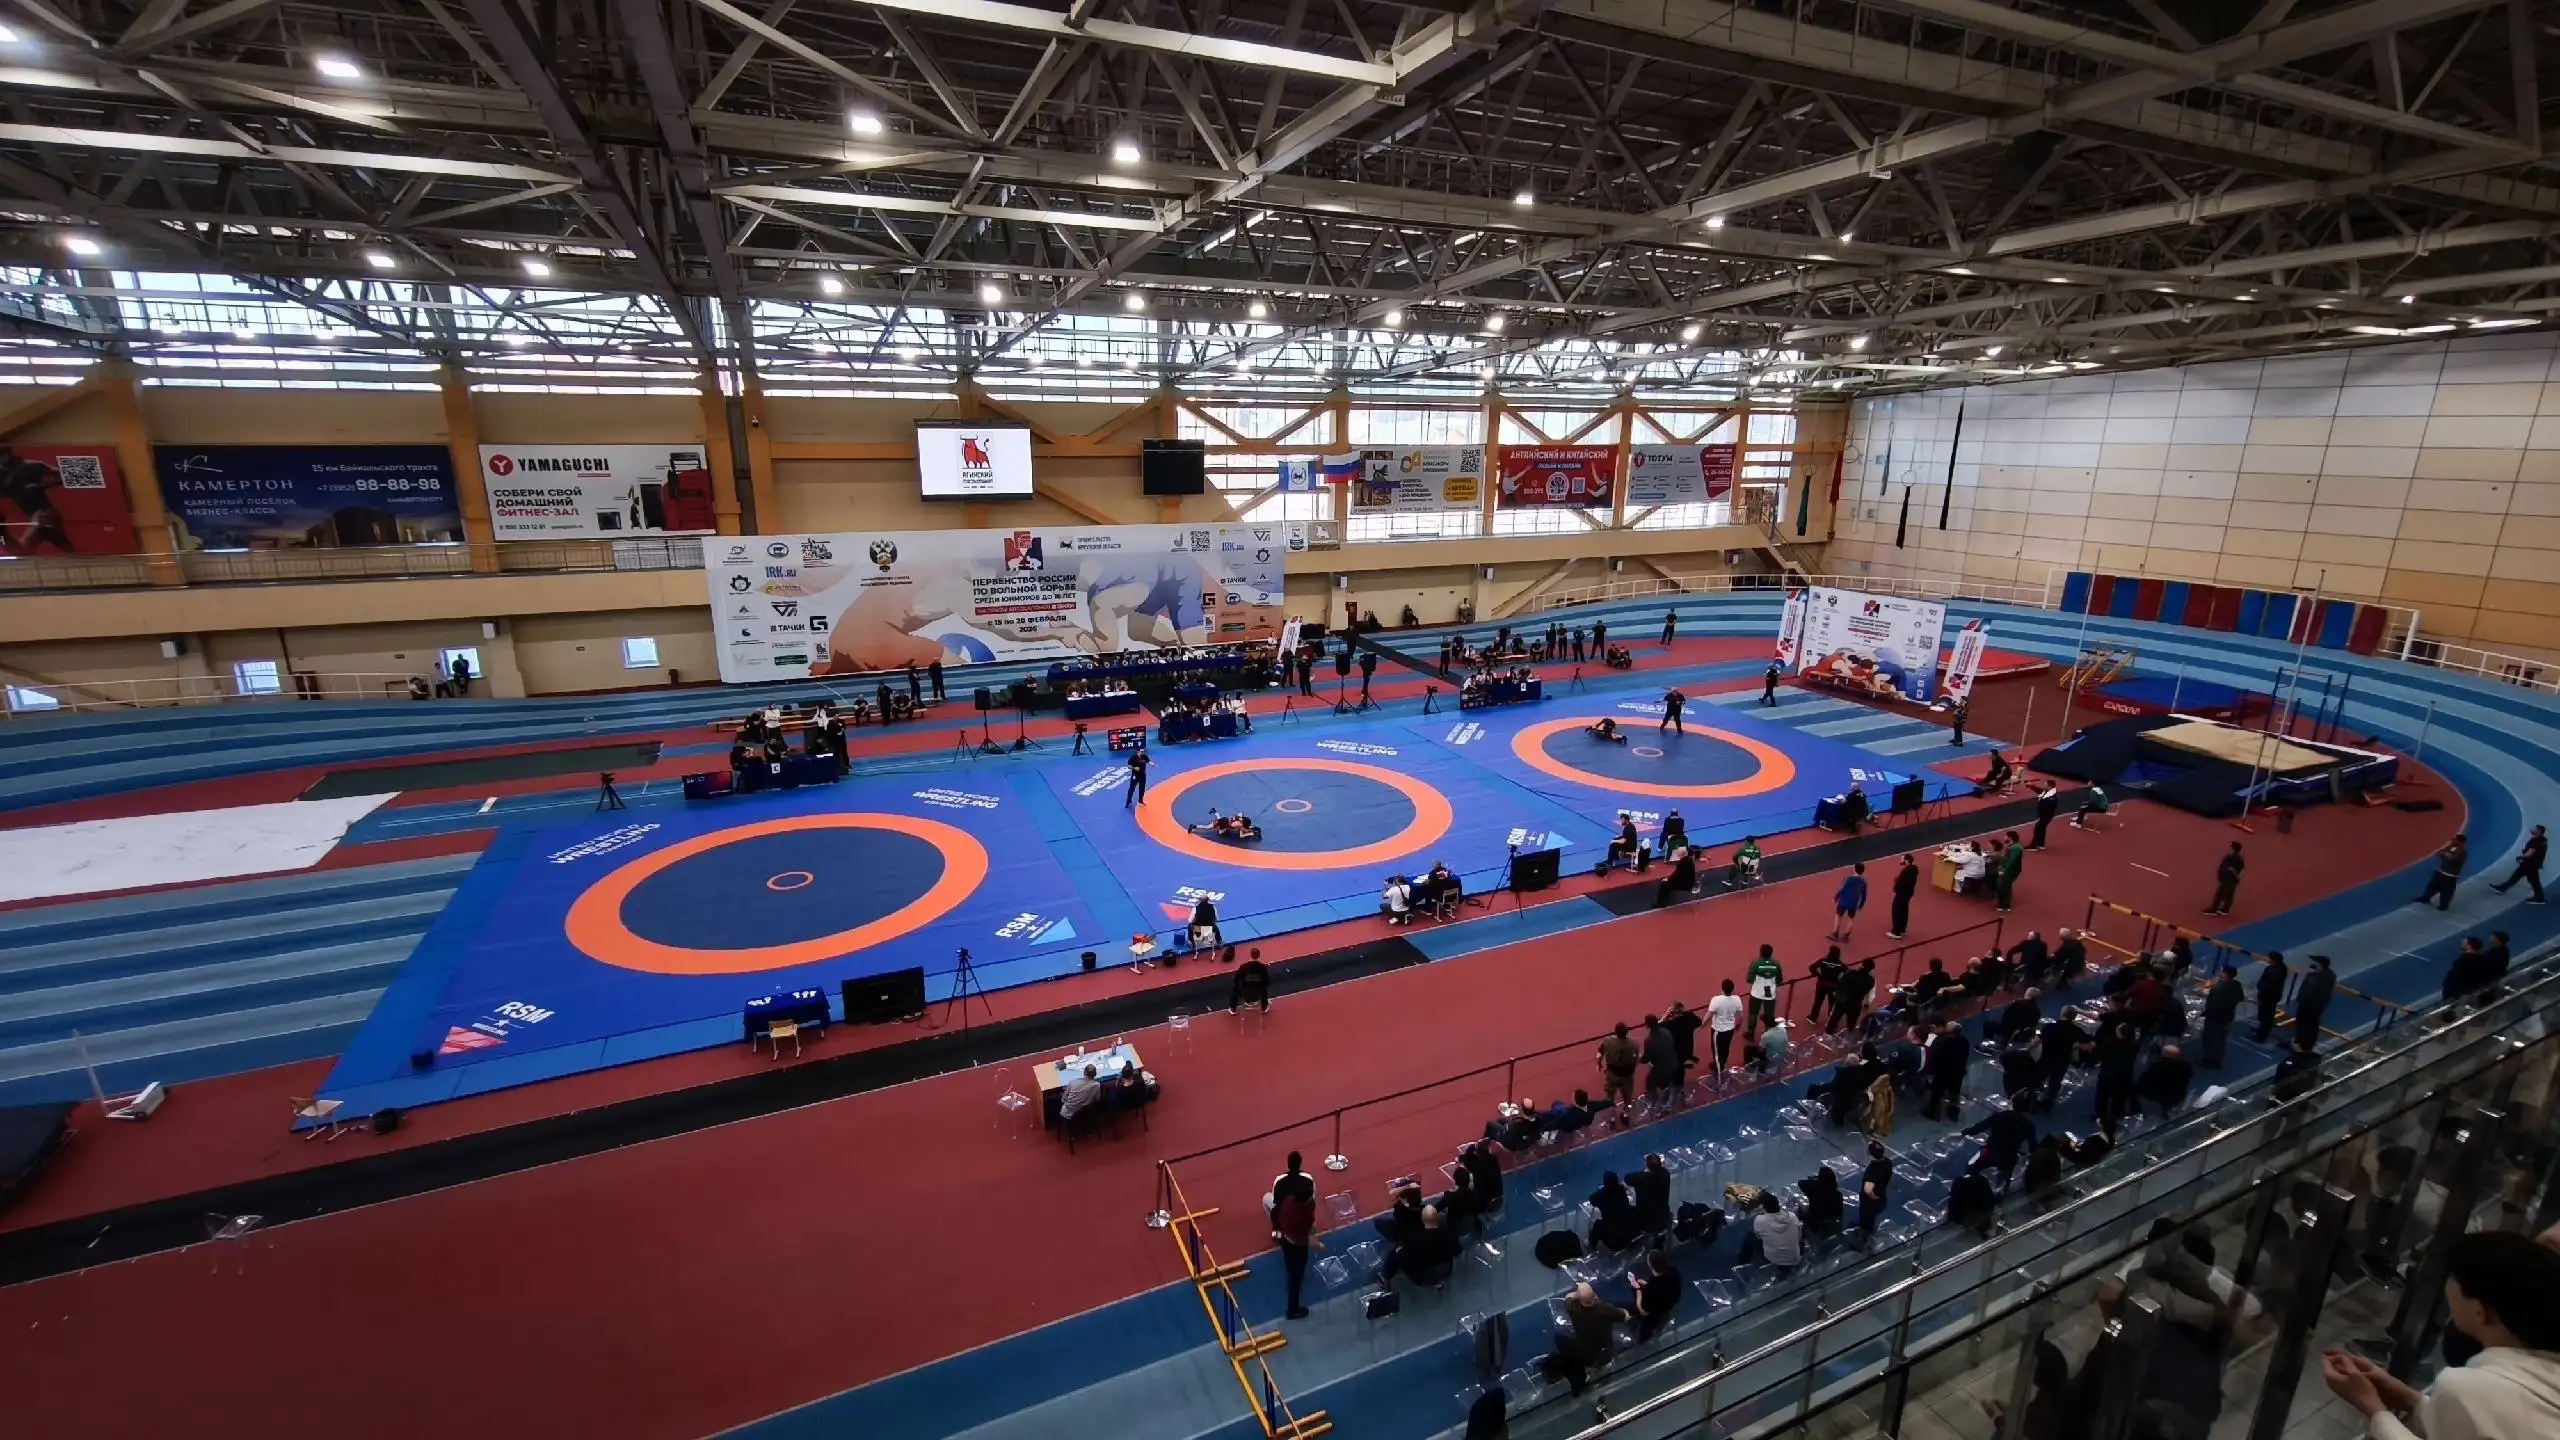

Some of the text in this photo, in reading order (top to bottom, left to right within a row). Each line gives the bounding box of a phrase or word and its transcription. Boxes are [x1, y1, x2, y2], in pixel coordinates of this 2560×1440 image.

[311, 464, 324, 472] 15
[407, 465, 438, 473] тракта
[518, 458, 610, 472] YAMAGUCHI
[179, 480, 293, 491] КАМЕРТОН
[355, 478, 440, 491] 98-88-98
[493, 486, 582, 497] СОБЕРИ СВОЙ
[495, 497, 574, 508] ДОМАШНИЙ
[497, 508, 580, 517] ФИТНЕС-ЗАЛ
[972, 574, 1076, 587] ПЕРВЕНСТВО РОССИИ
[973, 583, 1076, 596] ПО ВОЛЬНОЙ БОРЬБЕ
[974, 596, 1000, 604] СРЕДИ
[1001, 594, 1040, 603] ЮНИОРОВ
[1027, 615, 1067, 623] ФЕВРАЛЯ
[777, 623, 806, 632] ТАЧКИ
[912, 791, 999, 809] WRESTLING
[550, 823, 661, 864] WRESTLING
[995, 912, 1039, 938] RSM
[494, 1001, 556, 1024] RSM
